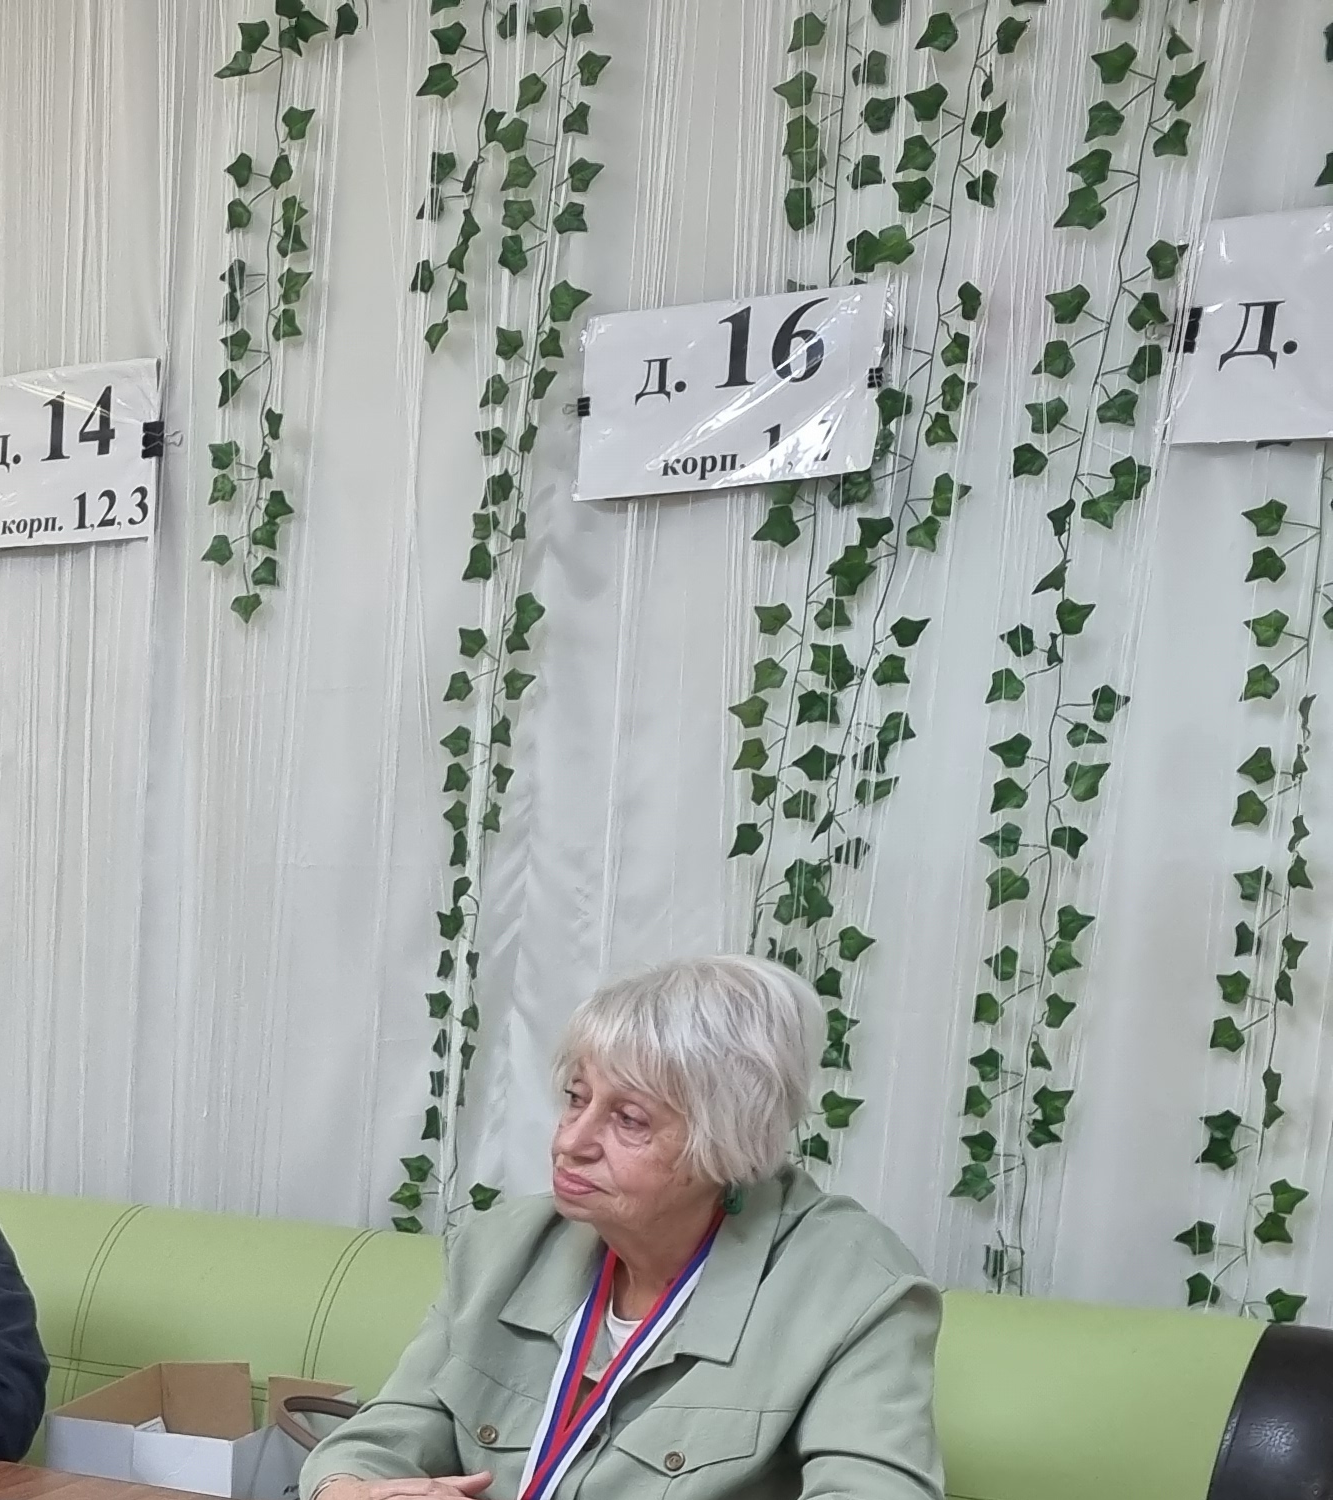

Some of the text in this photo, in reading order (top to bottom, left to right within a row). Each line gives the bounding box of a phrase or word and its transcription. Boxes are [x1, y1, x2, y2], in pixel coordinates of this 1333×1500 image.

[715, 297, 830, 389] 16
[1218, 300, 1298, 371] д.
[40, 385, 116, 461] 14
[661, 453, 746, 480] корп.
[1, 516, 64, 539] корп.
